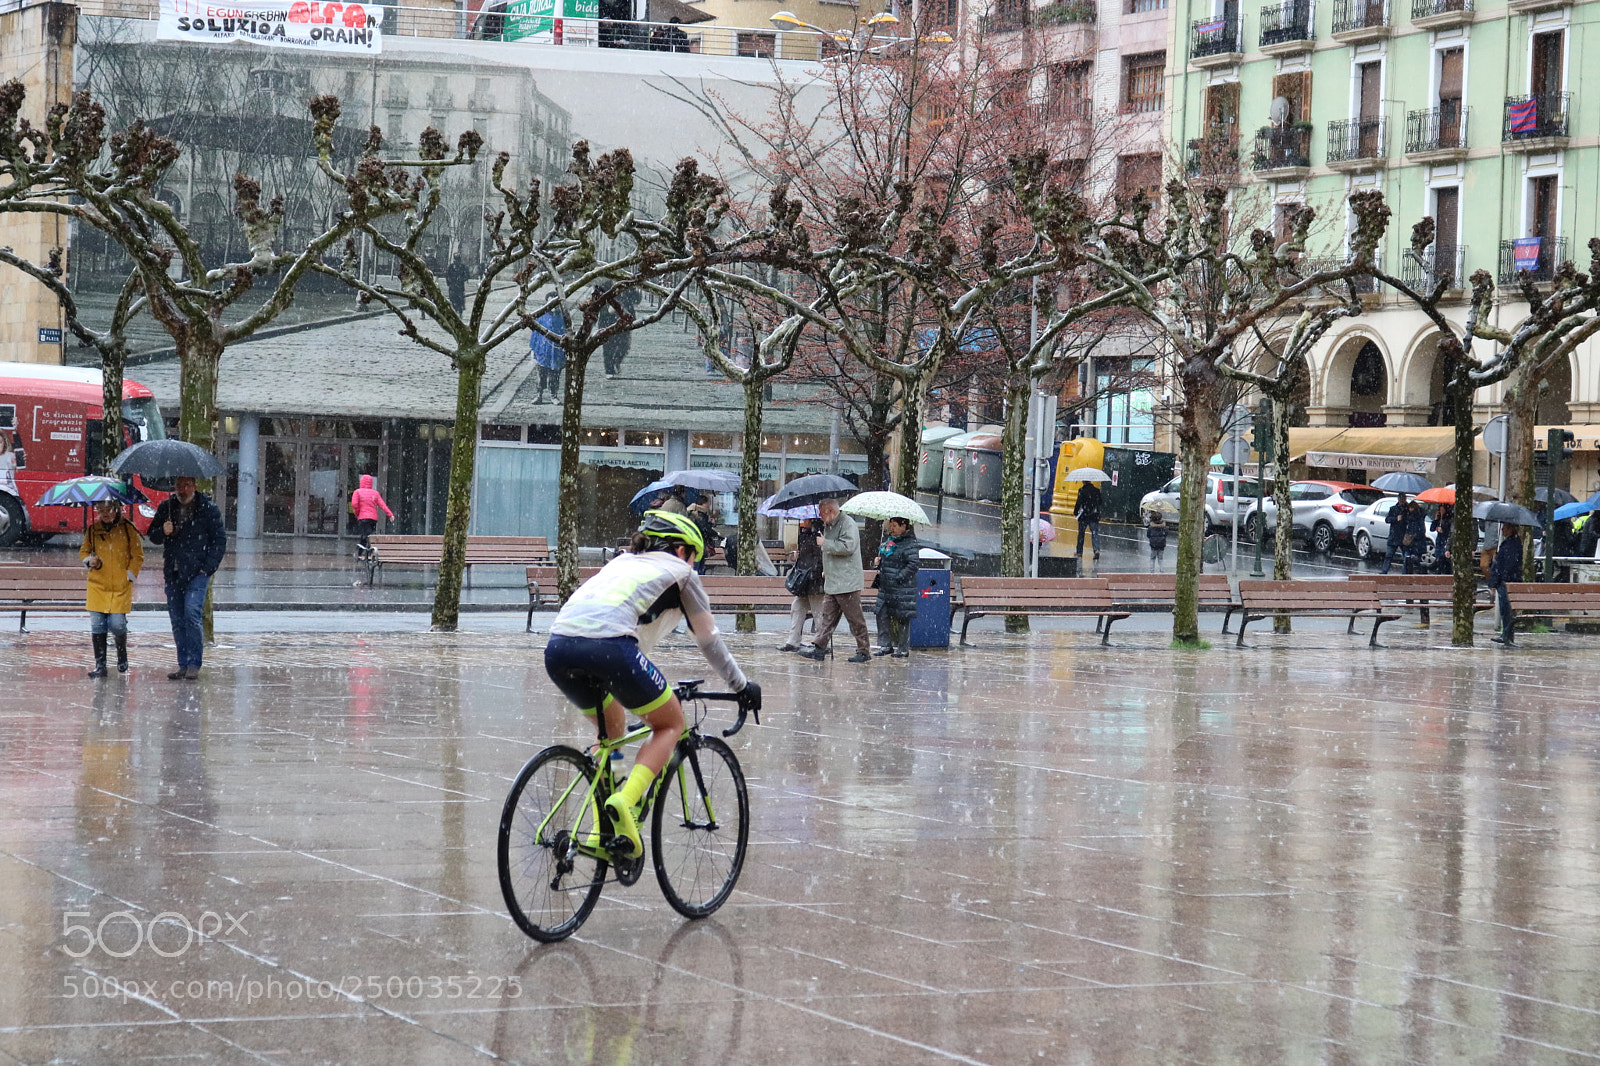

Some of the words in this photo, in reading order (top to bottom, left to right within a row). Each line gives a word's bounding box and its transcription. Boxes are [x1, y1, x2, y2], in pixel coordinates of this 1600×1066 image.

[207, 6, 243, 18] EGUN
[244, 10, 287, 22] GREBAN
[575, 0, 599, 13] bide
[177, 17, 286, 36] SOLUZIOA
[310, 27, 373, 48] ORAIN!
[635, 651, 665, 690] TELXIUS
